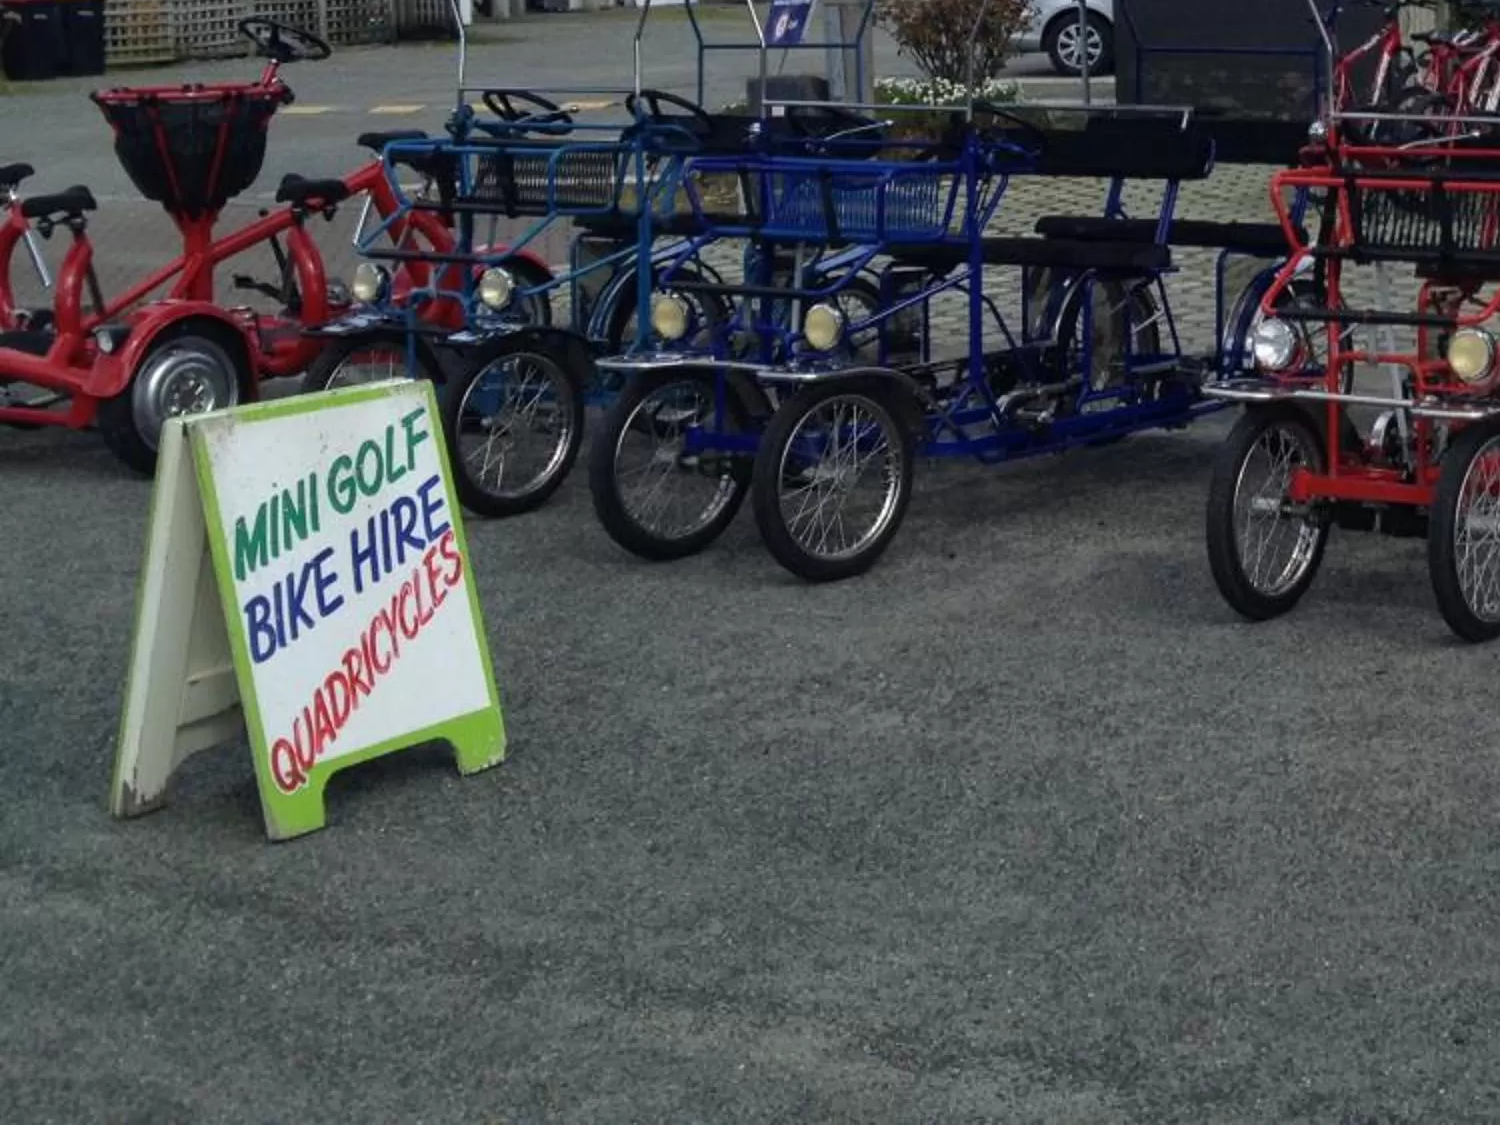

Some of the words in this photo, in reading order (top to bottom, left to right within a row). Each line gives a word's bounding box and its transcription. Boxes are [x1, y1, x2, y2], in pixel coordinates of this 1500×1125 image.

[234, 471, 320, 581] MINI
[327, 407, 429, 515] GOLF
[244, 546, 345, 664] BIKE
[349, 474, 451, 593] HIRE
[270, 530, 465, 793] QUADRICYCLES
